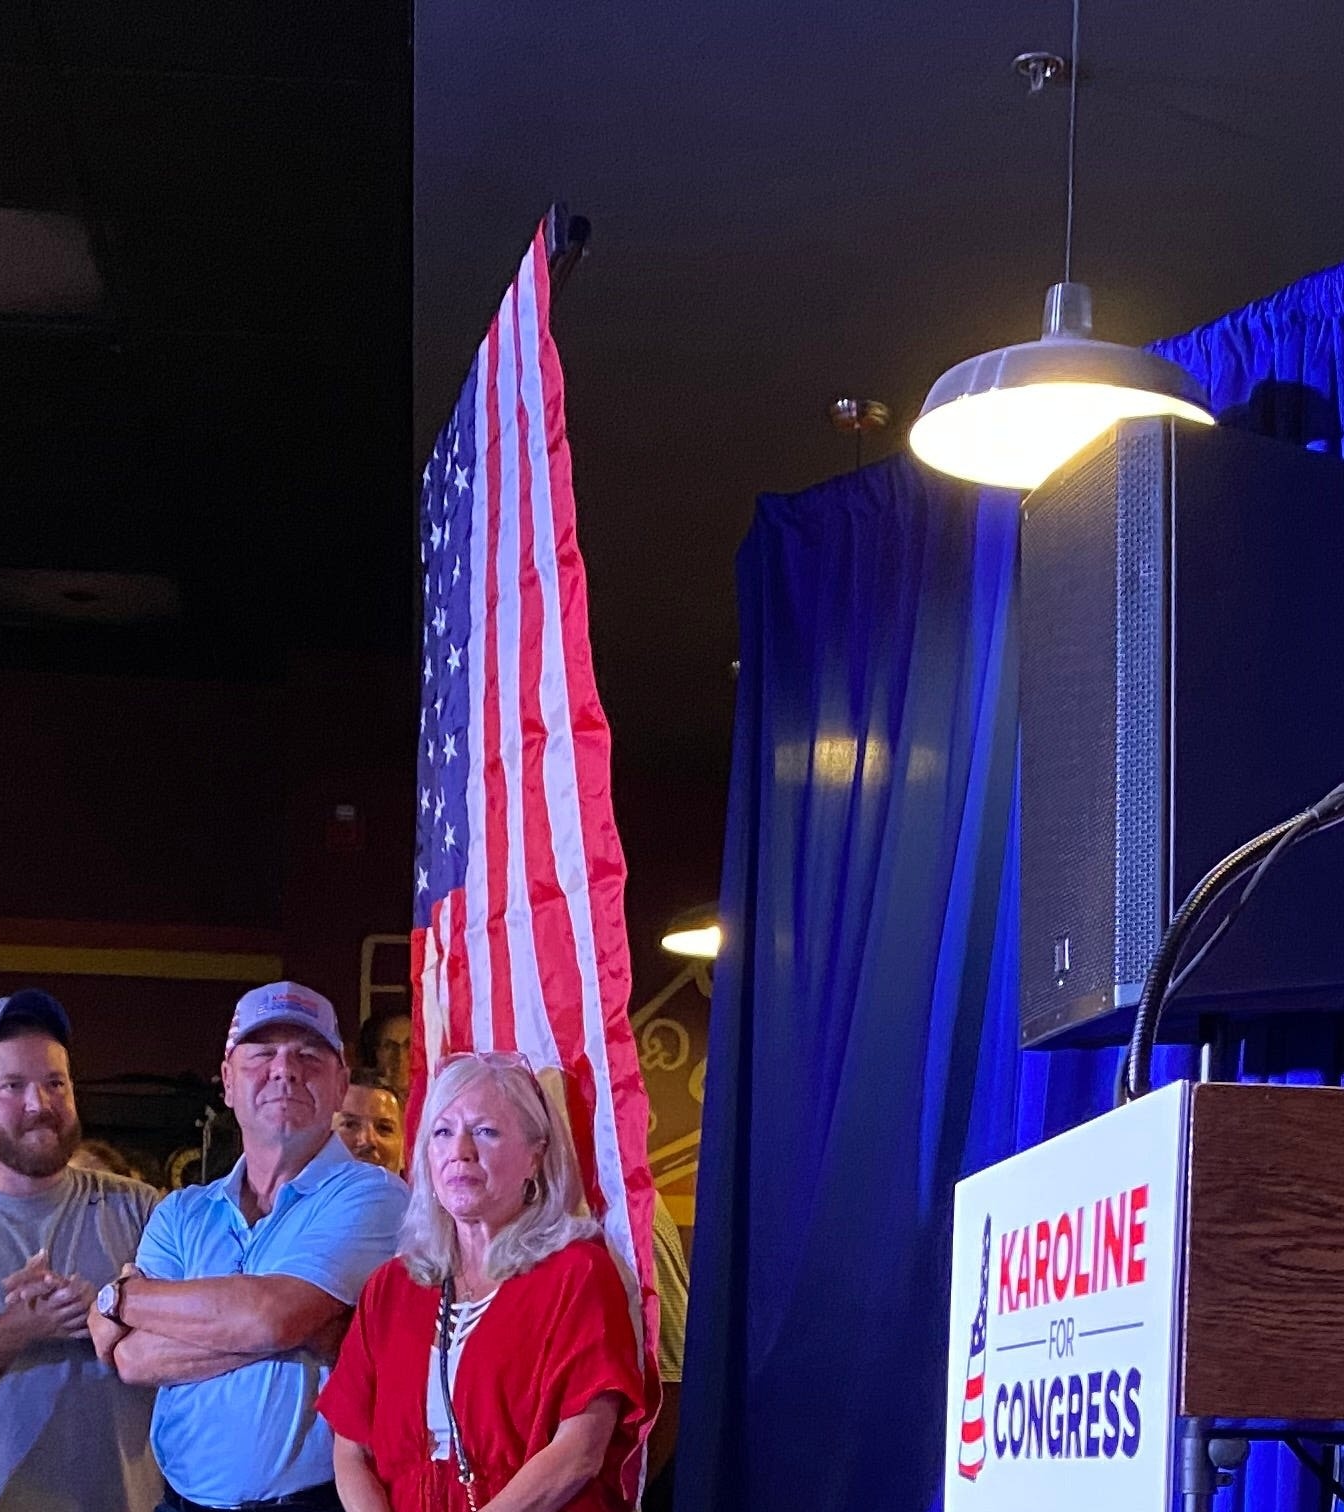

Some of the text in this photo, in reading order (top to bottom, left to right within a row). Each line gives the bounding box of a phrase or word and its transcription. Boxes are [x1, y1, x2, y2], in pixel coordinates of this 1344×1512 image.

[998, 1184, 1150, 1315] KAROLINE
[1048, 1317, 1075, 1360] FOR
[993, 1366, 1142, 1460] CONGRESS
